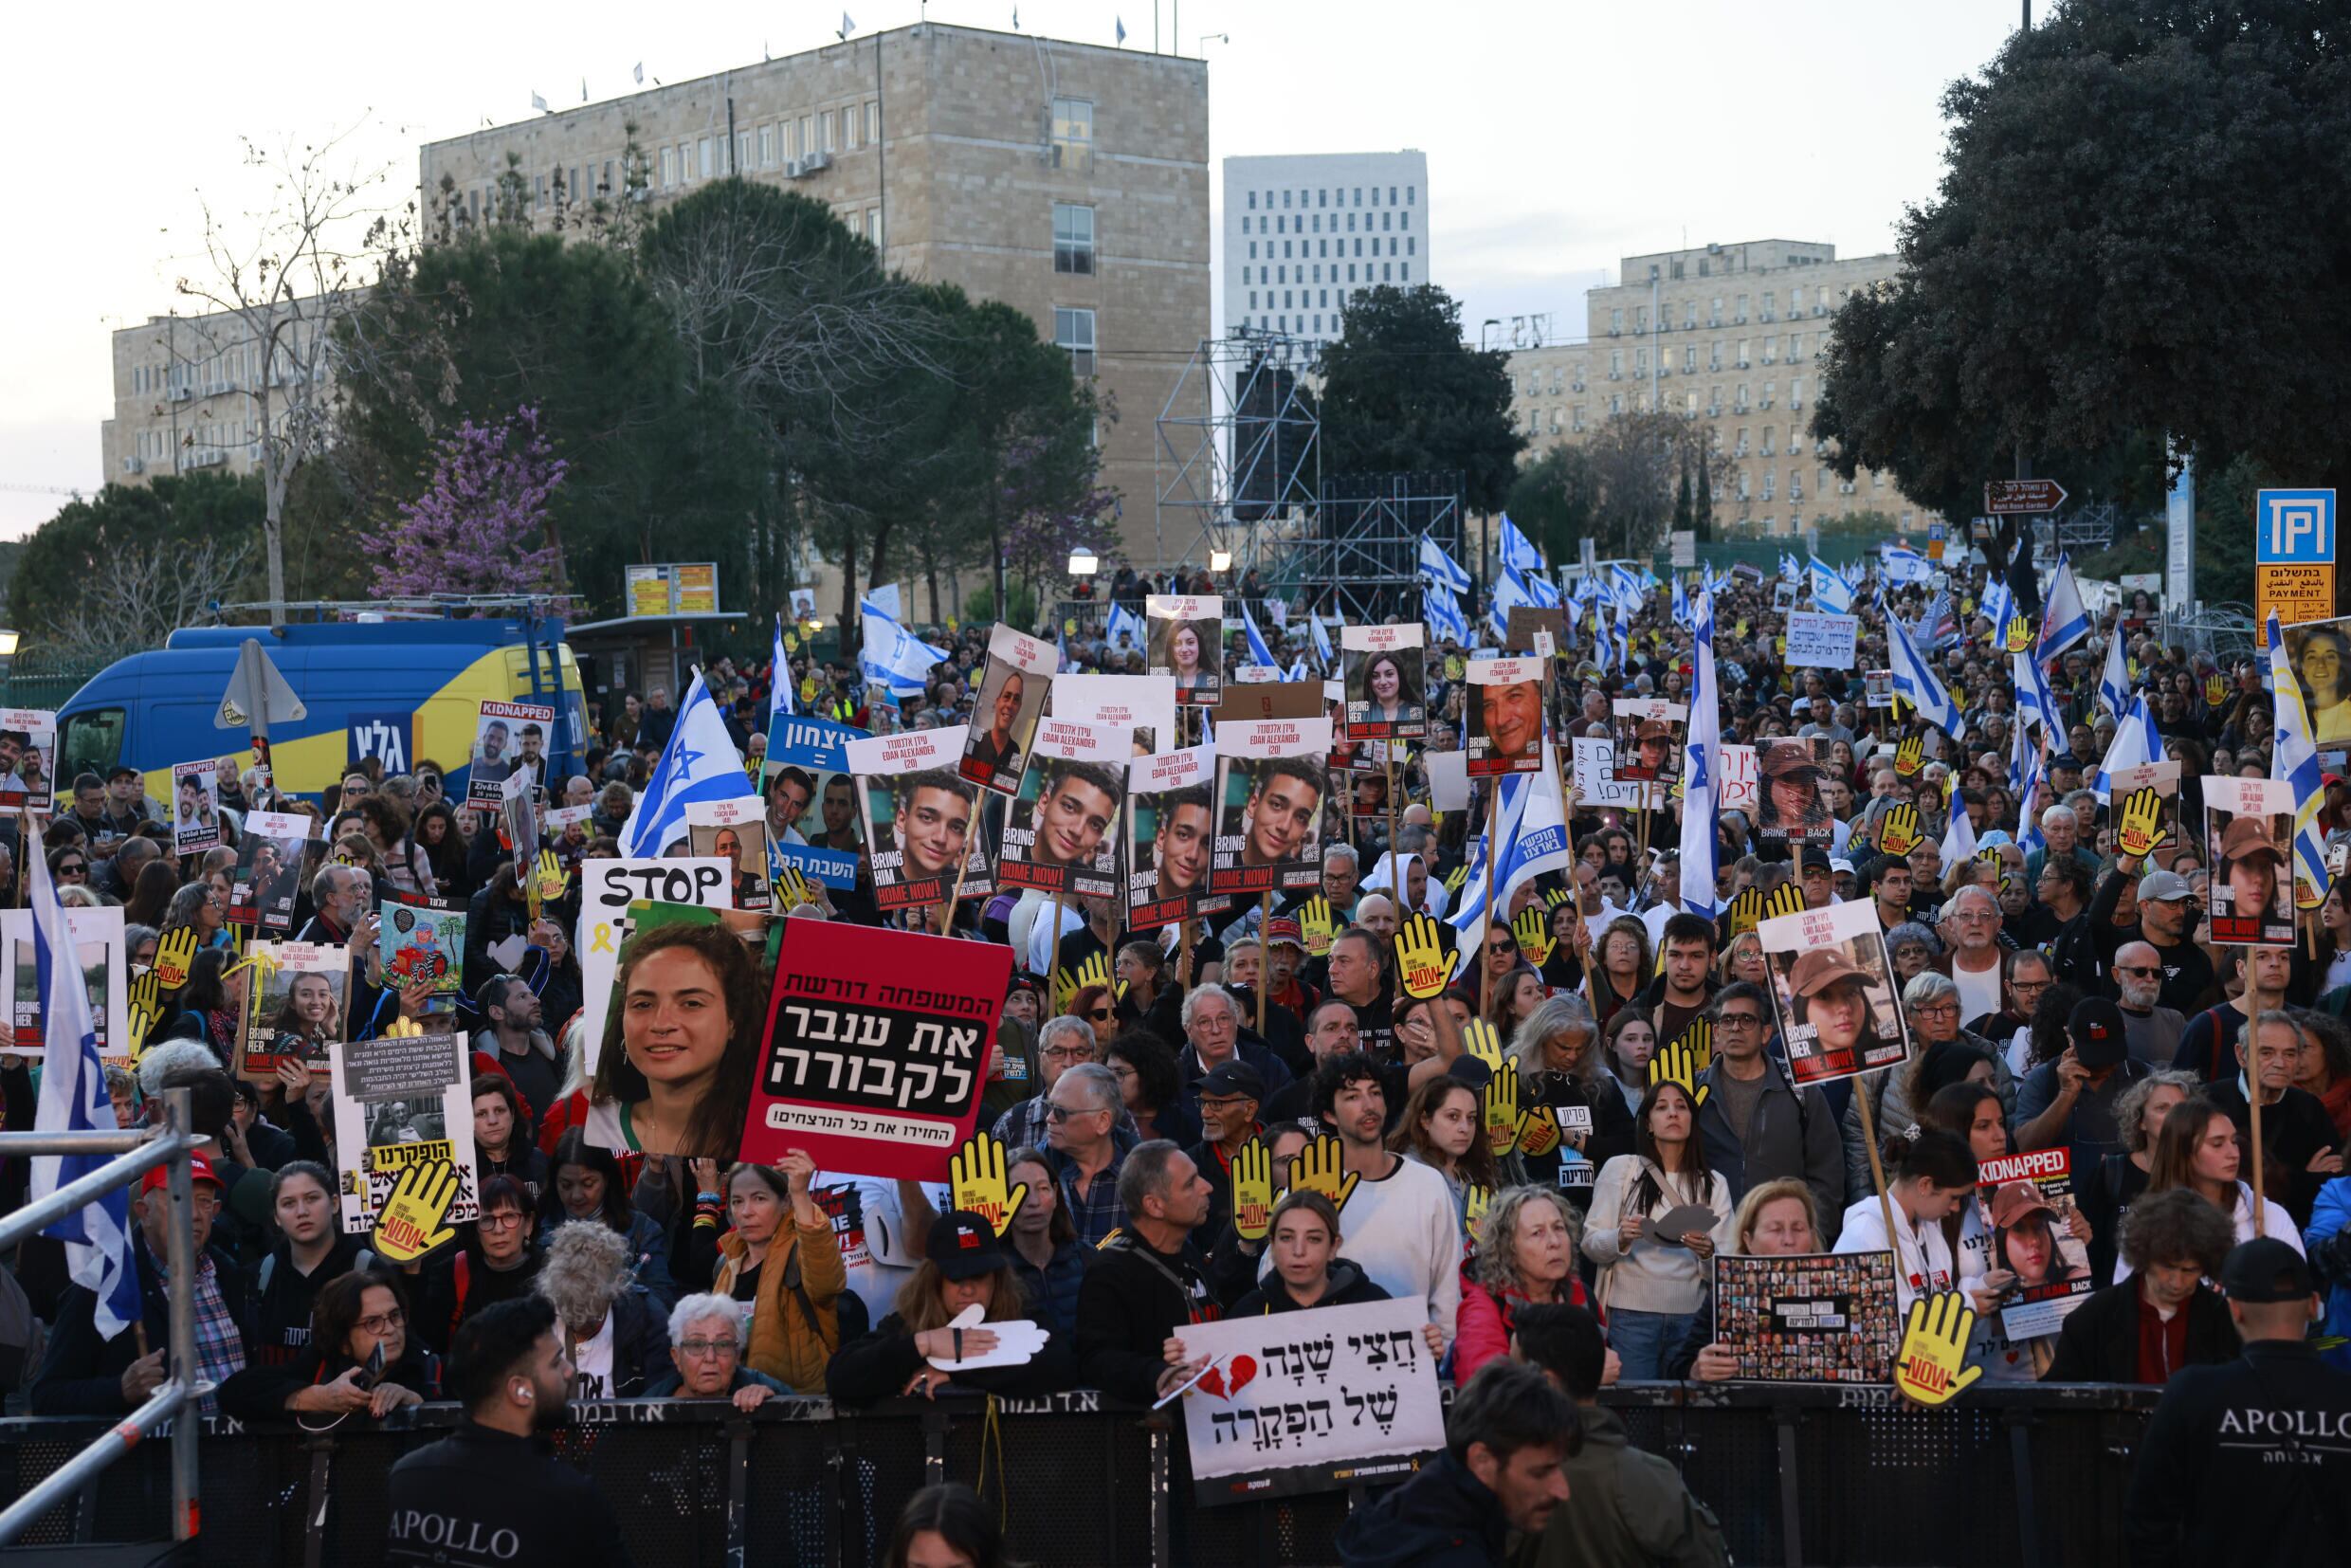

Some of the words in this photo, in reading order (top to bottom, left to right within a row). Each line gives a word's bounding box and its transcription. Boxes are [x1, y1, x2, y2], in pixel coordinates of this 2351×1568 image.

[1994, 501, 2008, 510] Wohl
[2270, 568, 2321, 577] בתשלום
[483, 702, 551, 720] KIDNAPPED
[1348, 701, 1369, 711] BRING
[1348, 712, 1362, 722] HER
[1078, 727, 1091, 737] עידן
[1283, 724, 1295, 734] עידן
[915, 736, 928, 747] עידן
[1043, 733, 1059, 743] EDAN
[1060, 735, 1097, 748] ALEXANDER
[1250, 735, 1266, 745] EDAN
[1267, 734, 1300, 744] ALEXANDER
[1469, 737, 1490, 747] BRING
[883, 750, 899, 760] EDAN
[901, 745, 936, 759] ALEXANDER
[1062, 746, 1075, 757] (20)
[1268, 745, 1281, 755] (20)
[1469, 749, 1483, 758] HIM
[175, 760, 214, 775] KIDNAPPED
[904, 759, 918, 769] (20)
[1152, 768, 1167, 778] EDAN
[1167, 762, 1198, 775] ALEXANDER
[1170, 777, 1181, 787] (20)
[2240, 793, 2249, 802] LIRI
[2249, 793, 2264, 803] ALBAG
[1003, 828, 1035, 847] BRING
[1521, 829, 1557, 847] חופשי
[1761, 828, 1787, 837] BRING
[1807, 828, 1832, 837] BACK
[2124, 829, 2151, 848] NOW
[1215, 835, 1246, 852] BRING
[1523, 838, 1561, 860] בארצנו
[871, 851, 903, 869] BRING
[1002, 844, 1022, 862] HIM
[1214, 853, 1233, 869] HIM
[808, 858, 854, 879] השבת
[1001, 862, 1030, 881] HOME
[1032, 866, 1065, 885] NOW!
[1213, 869, 1242, 887] HOME
[1244, 866, 1273, 885] NOW!
[874, 868, 895, 886] HIM
[1130, 869, 1158, 890] BRING
[1283, 876, 1303, 885] FAMILIES
[1303, 874, 1320, 884] FORUM
[600, 866, 722, 906] STOP
[877, 885, 908, 903] HOME
[910, 880, 941, 900] NOW!
[1074, 884, 1096, 893] FAMILIES
[1097, 886, 1114, 896] FORUM
[2212, 885, 2235, 901] BRING
[429, 897, 447, 908] אלעד
[1131, 889, 1149, 907] HIM
[1132, 905, 1157, 925] HOME
[1160, 896, 1188, 920] NOW!
[1197, 903, 1215, 913] FAMILIES
[2212, 903, 2227, 917] HER
[1803, 926, 1813, 936] LIRI
[1814, 922, 1833, 935] ALBAG
[2213, 919, 2234, 935] HOME
[2235, 920, 2260, 935] NOW!
[157, 964, 185, 981] NOW
[1409, 965, 1441, 987] NOW
[784, 974, 869, 996] דורשת
[15, 1001, 41, 1013] BRING
[879, 985, 993, 1015] המשפחה
[15, 1014, 32, 1027] HER
[785, 1006, 891, 1047] ענבר
[248, 1028, 275, 1041] BRING
[907, 1022, 978, 1059] את
[1786, 1022, 1817, 1043] BRING
[247, 1040, 264, 1052] HER
[426, 1044, 451, 1052] בעקבות
[1789, 1041, 1812, 1059] HER
[246, 1055, 271, 1067] HOME
[396, 1063, 421, 1072] קיצונית
[422, 1061, 452, 1069] ללאומנות
[1794, 1056, 1824, 1076] HOME
[1826, 1049, 1855, 1068] NOW!
[360, 1074, 392, 1083] התבהמות
[408, 1079, 431, 1087] האחרון
[771, 1048, 972, 1108] לקבורה
[774, 1110, 844, 1129] הנרצחים!
[1562, 1108, 1586, 1124] פדיון
[849, 1118, 868, 1131] כל
[873, 1122, 897, 1136] את
[903, 1125, 950, 1141] החזירו
[379, 1142, 450, 1165] הופקרנו
[1977, 1150, 2064, 1184] KIDNAPPED
[1562, 1167, 1594, 1184] למדינה
[1240, 1204, 1267, 1224] NOW
[383, 1216, 426, 1249] NOW
[2025, 1287, 2041, 1303] LIRI
[2043, 1281, 2070, 1298] ALBAG
[2071, 1280, 2091, 1293] BACK
[1789, 1316, 1814, 1325] למדינה
[1905, 1355, 1952, 1391] NOW
[2218, 1408, 2351, 1439] APOLLO
[388, 1508, 520, 1559] APOLLO
